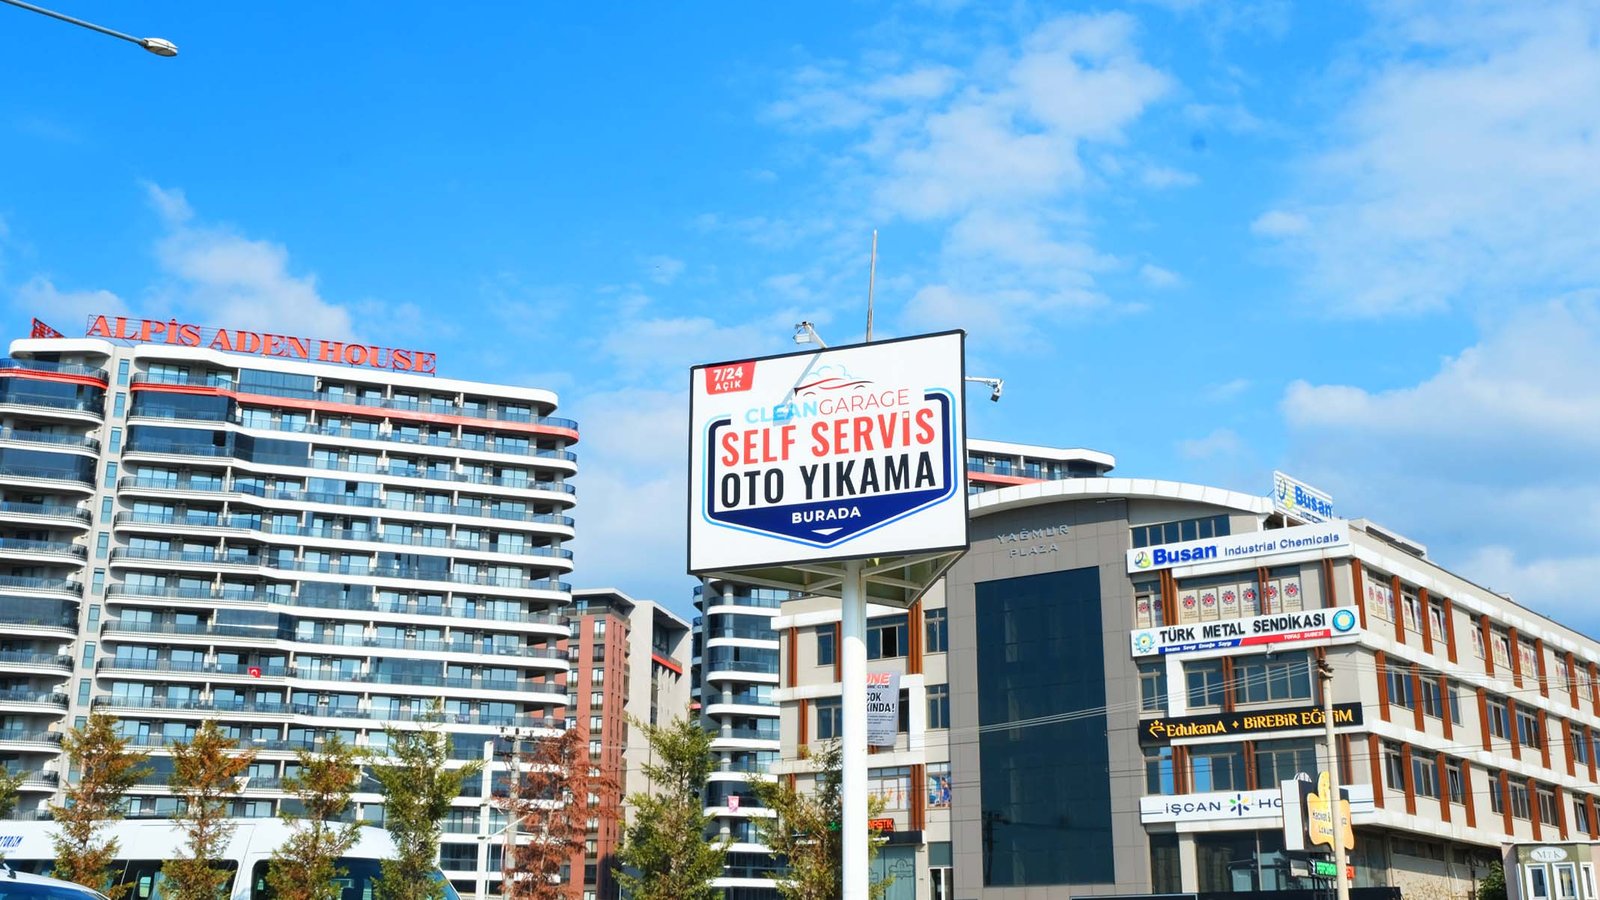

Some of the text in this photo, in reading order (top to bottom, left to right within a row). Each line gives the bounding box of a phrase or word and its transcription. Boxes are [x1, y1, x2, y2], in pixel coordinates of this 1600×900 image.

[209, 328, 311, 360] ADEN
[317, 340, 435, 373] HOUSE
[713, 366, 743, 382] 7/24
[714, 380, 742, 391] AÇIK
[721, 425, 797, 467] SELF
[721, 451, 936, 509] OTO YIKAMA
[791, 506, 861, 524] BURADA
[1294, 485, 1333, 519] Busan
[1009, 543, 1058, 559] PLAZA
[1153, 533, 1340, 565] Busan Industrial Chemicals
[1159, 612, 1326, 644] TÜRK METAL SENDİKASI
